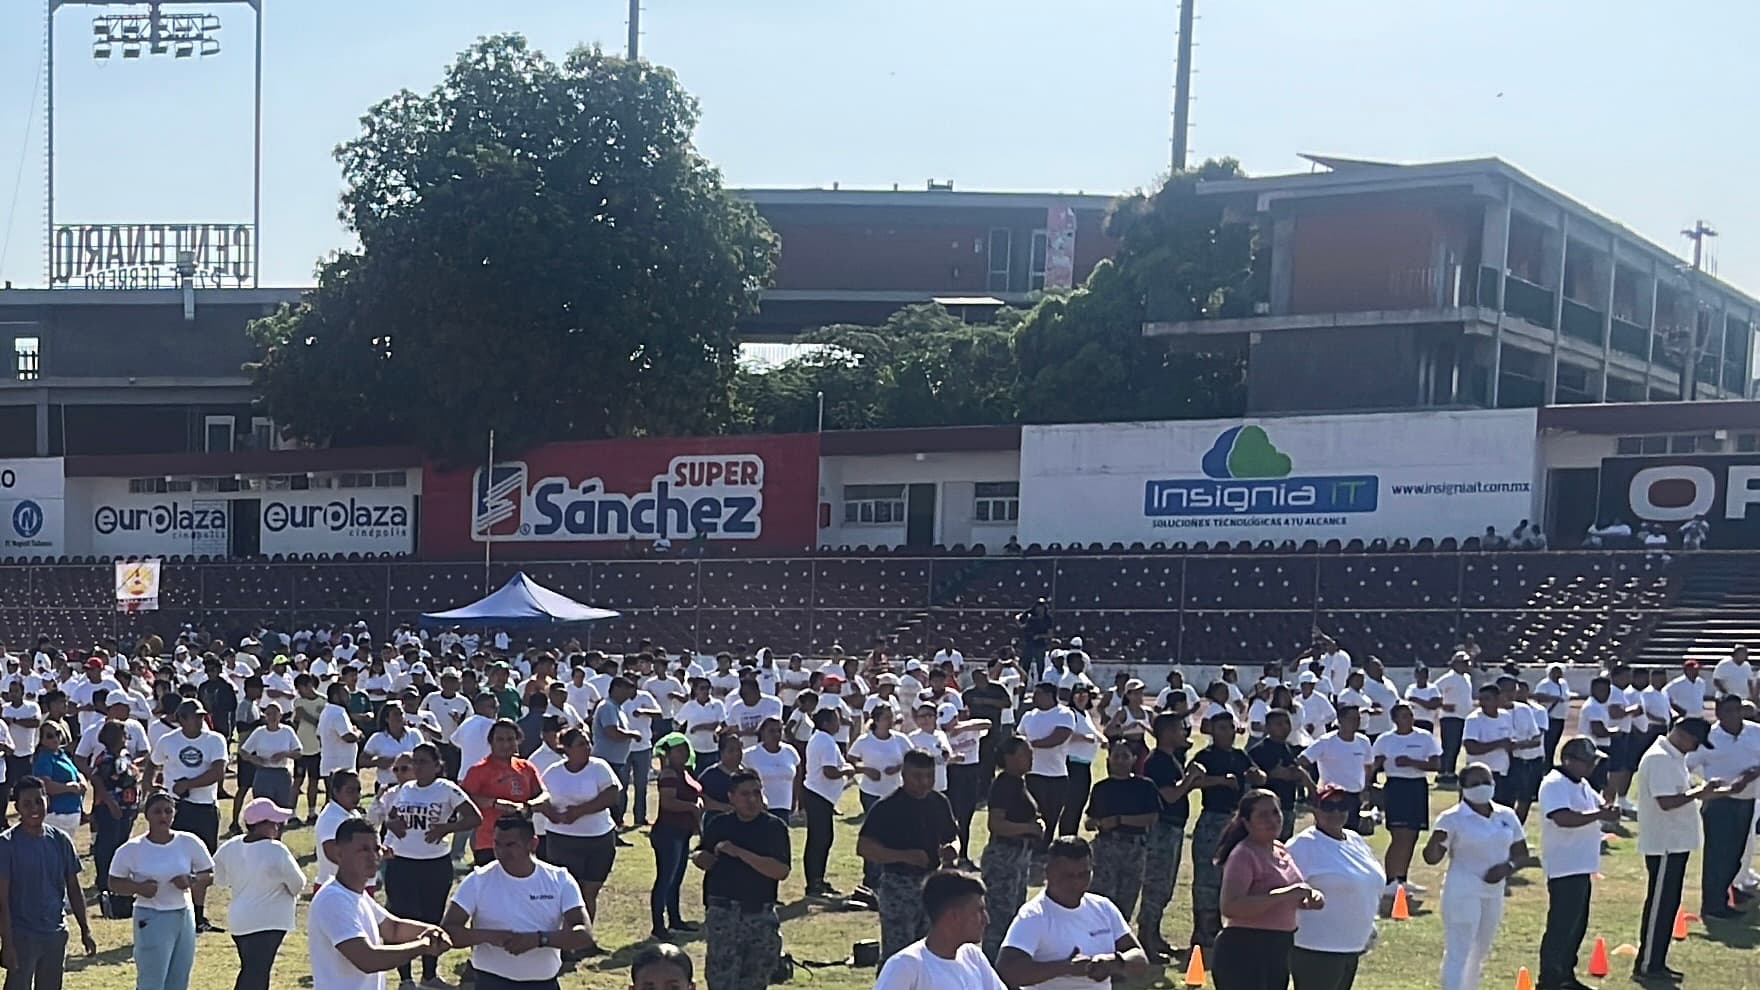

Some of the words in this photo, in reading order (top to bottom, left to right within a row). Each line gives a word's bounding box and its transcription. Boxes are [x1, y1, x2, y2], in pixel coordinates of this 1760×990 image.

[674, 461, 758, 487] SUPER
[534, 480, 757, 535] Sánchez
[1152, 483, 1317, 513] Insignia
[1331, 480, 1368, 506] IT
[1152, 518, 1210, 529] SOLUCIONES
